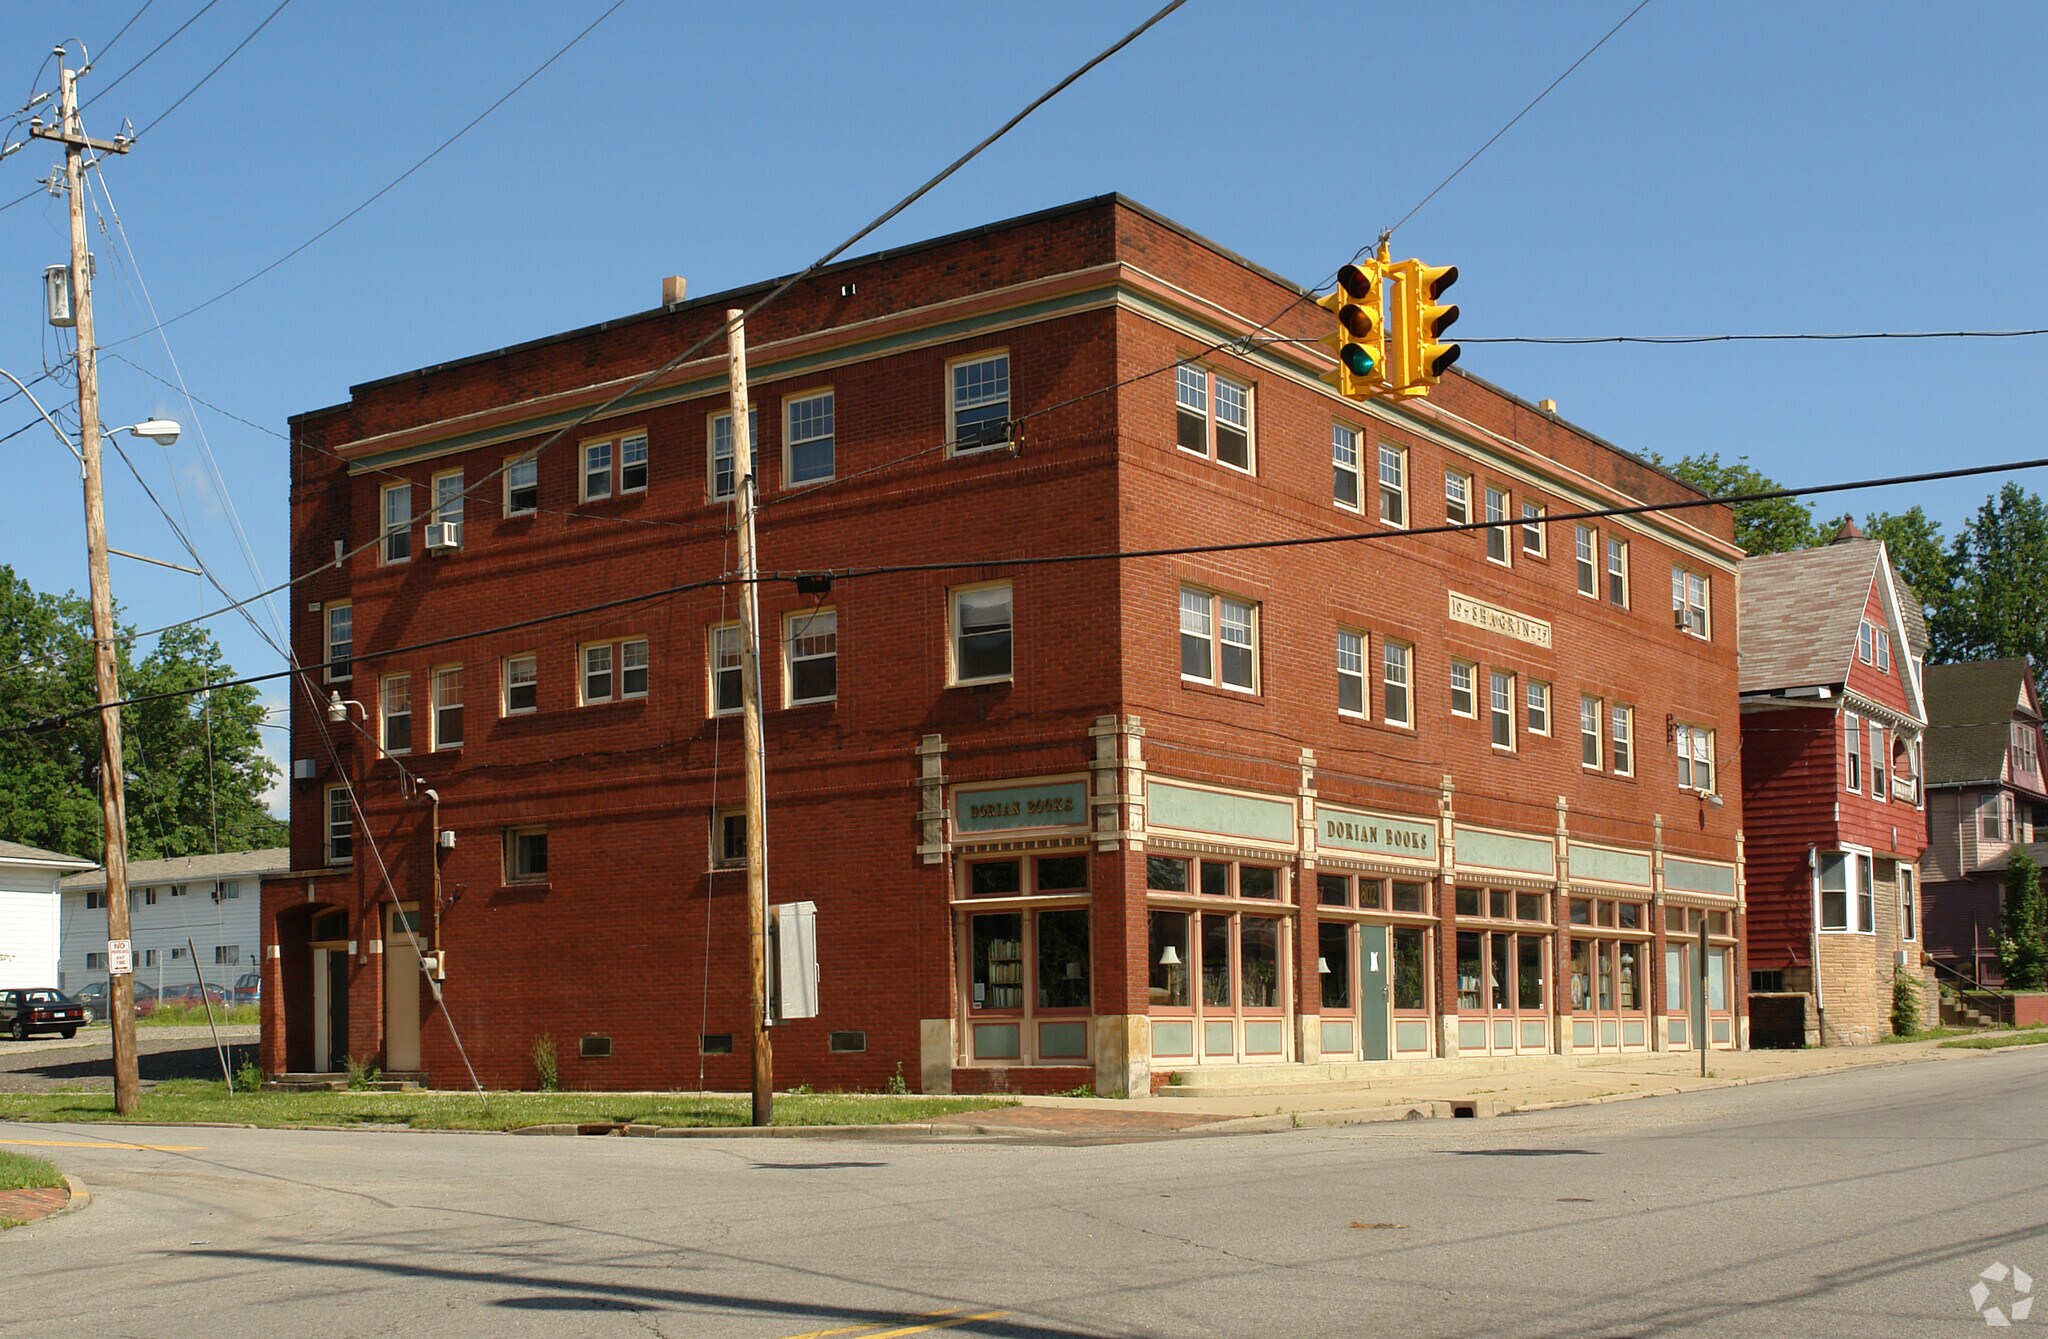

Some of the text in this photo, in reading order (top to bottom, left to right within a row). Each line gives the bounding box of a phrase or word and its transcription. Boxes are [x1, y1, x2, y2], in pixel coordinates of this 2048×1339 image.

[970, 797, 1074, 819] DORIAN BOOKS
[1327, 820, 1427, 850] DORIAN BOOKS
[1361, 885, 1376, 904] 802
